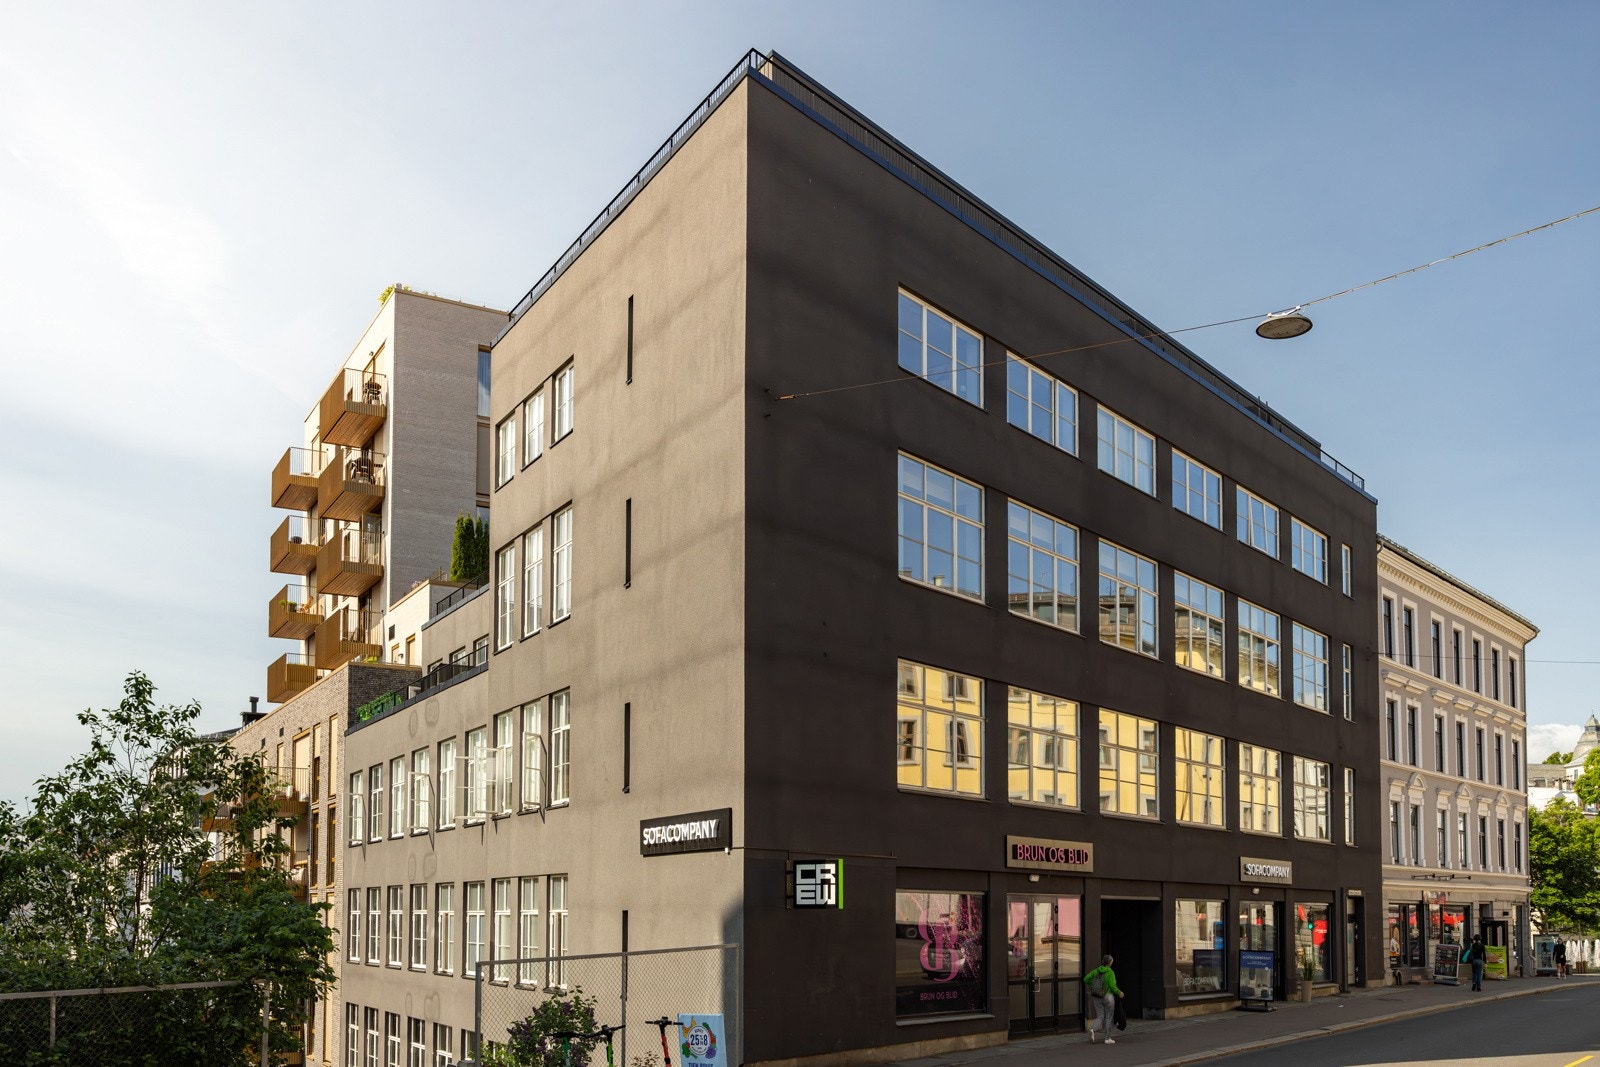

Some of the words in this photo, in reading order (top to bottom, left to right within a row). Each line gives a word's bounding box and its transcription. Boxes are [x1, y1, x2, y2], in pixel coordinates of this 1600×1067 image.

[643, 819, 718, 845] SOFACOMPANY
[1017, 844, 1046, 861] BRUN
[1049, 846, 1066, 863] OG
[1068, 848, 1089, 864] BLID
[1246, 863, 1290, 878] SOFACOMPANY
[919, 992, 935, 1001] BRUN
[936, 991, 945, 1000] OG
[946, 990, 958, 999] BLID
[703, 1034, 708, 1046] 8
